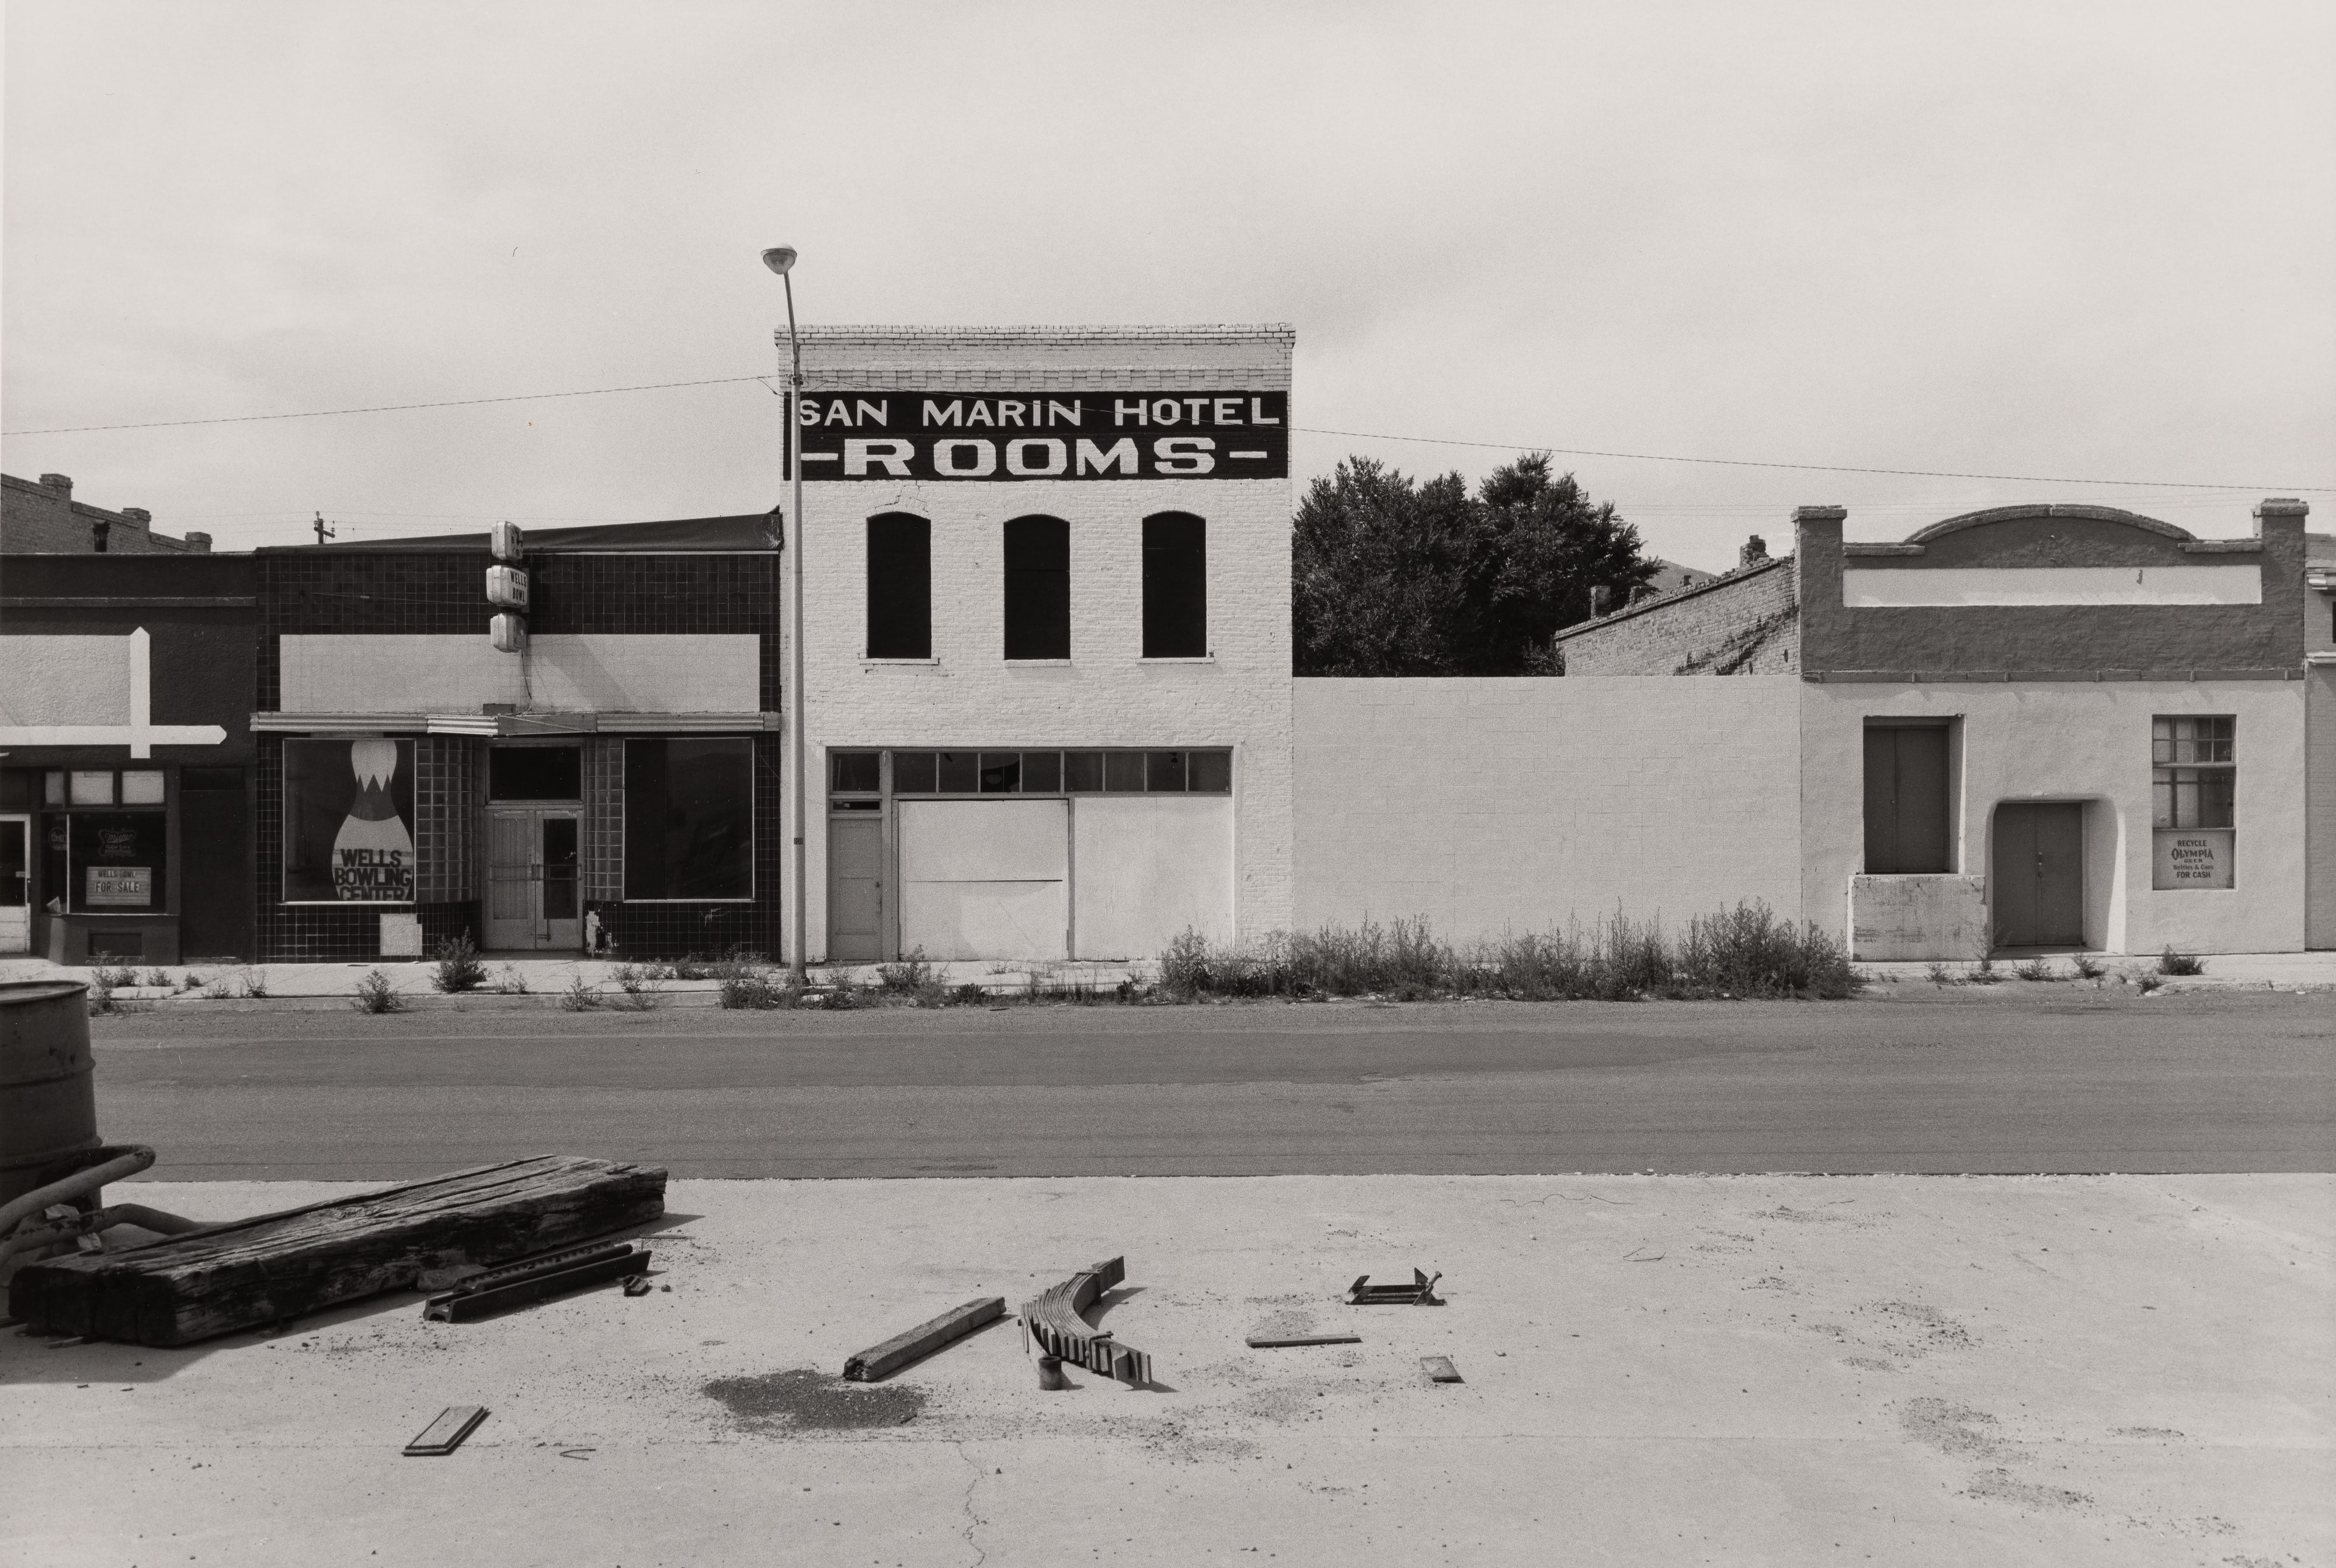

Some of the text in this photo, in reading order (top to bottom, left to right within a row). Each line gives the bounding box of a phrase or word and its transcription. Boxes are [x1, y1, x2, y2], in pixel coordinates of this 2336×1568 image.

[800, 397, 1280, 426] SAN MARIN HOTEL
[510, 571, 526, 587] WELLS
[513, 587, 525, 602] BOWL
[105, 833, 133, 843] Miller
[340, 849, 402, 868] WELLS
[2171, 847, 2214, 861] OLYMPIA
[335, 868, 412, 886] BOWLING
[96, 881, 140, 892] FOR SALE
[340, 886, 405, 901] CENTER
